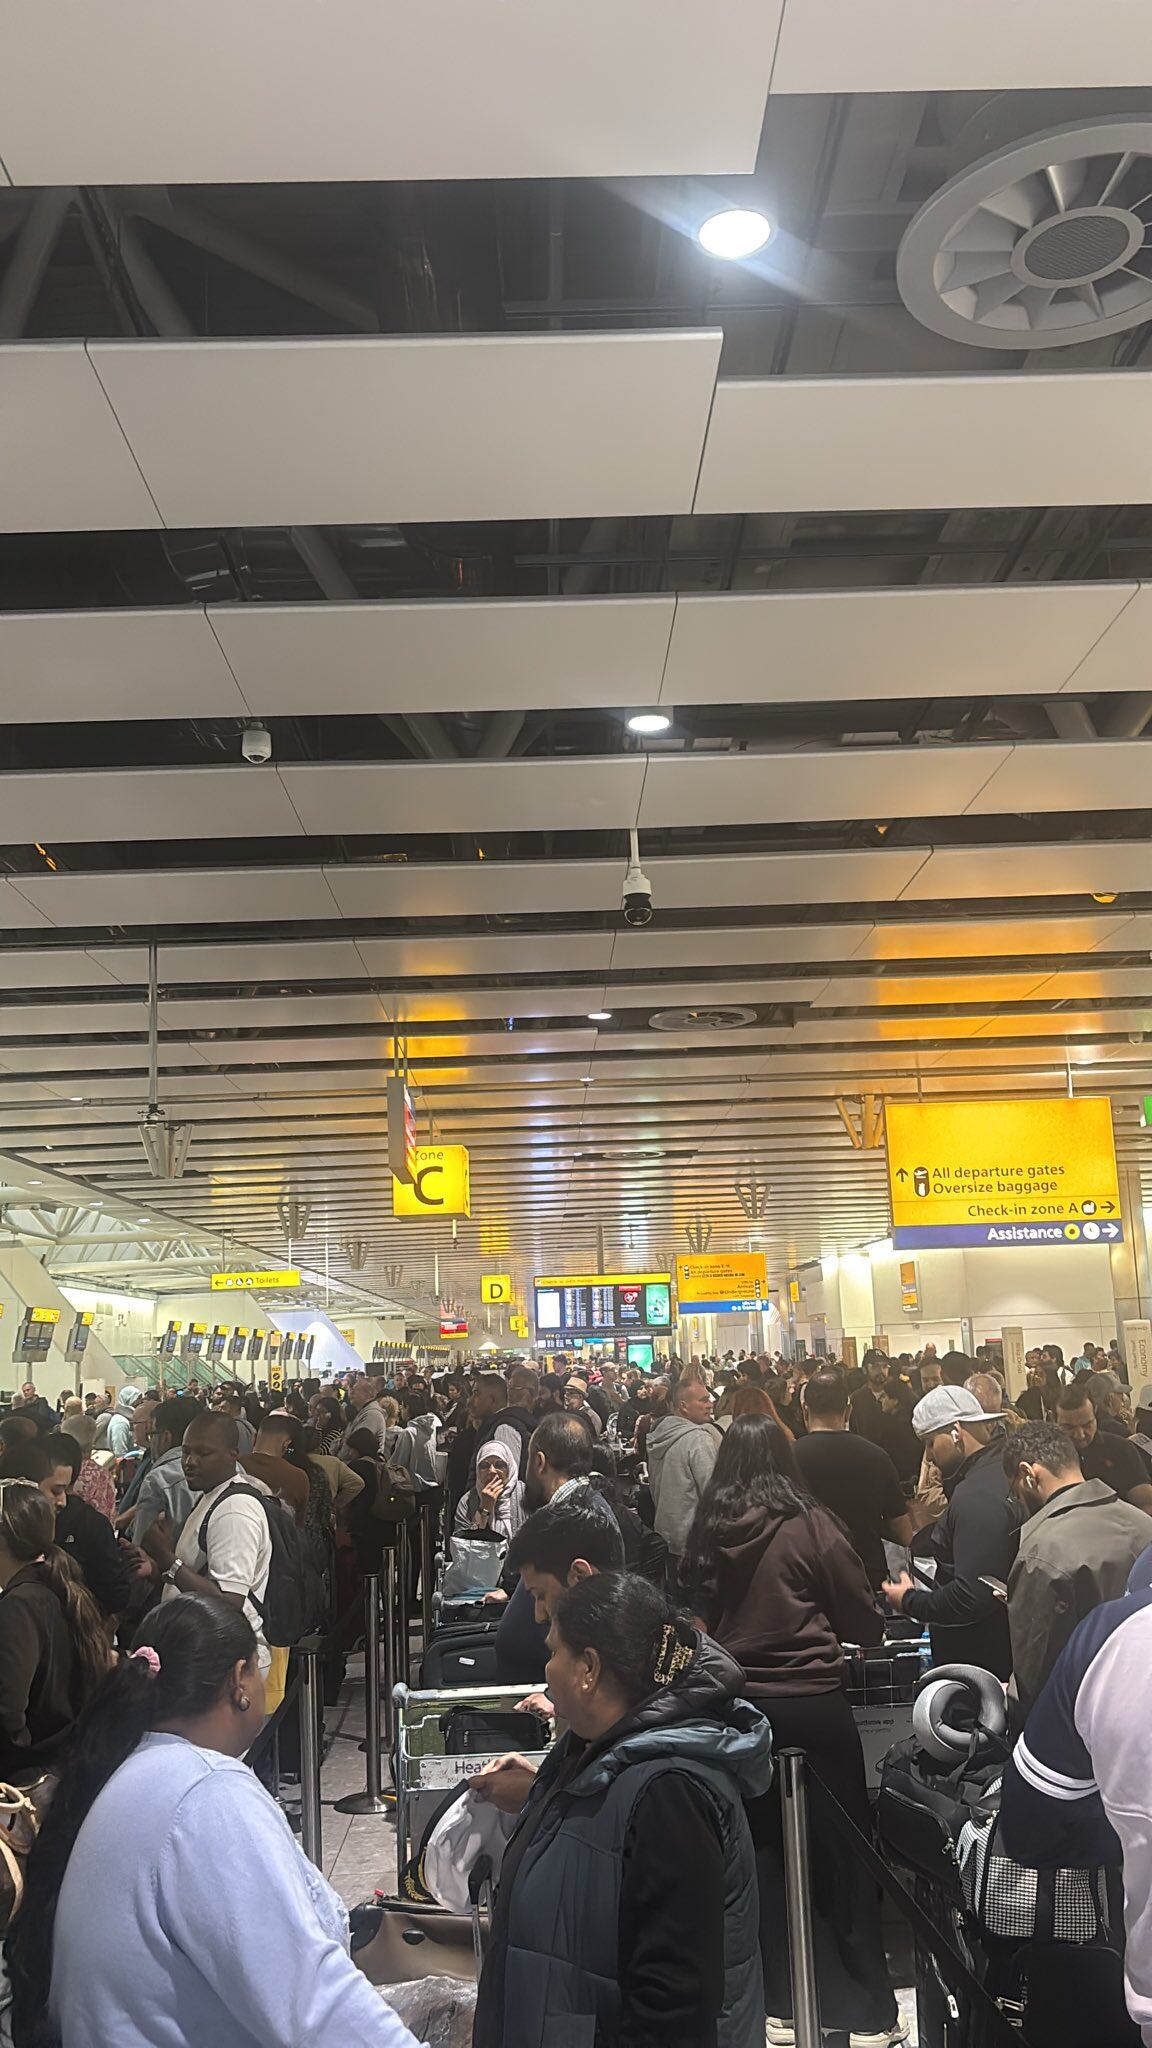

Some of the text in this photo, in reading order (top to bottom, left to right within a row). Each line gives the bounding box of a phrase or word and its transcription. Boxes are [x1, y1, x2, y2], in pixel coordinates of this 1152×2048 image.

[932, 1165, 1065, 1180] All departure gates
[413, 1166, 444, 1206] C
[933, 1181, 1058, 1194] Oversize baggage
[968, 1202, 1079, 1217] Check-in zone A
[988, 1227, 1062, 1241] Assistance
[490, 1283, 503, 1299] D
[1139, 1339, 1148, 1378] Economy
